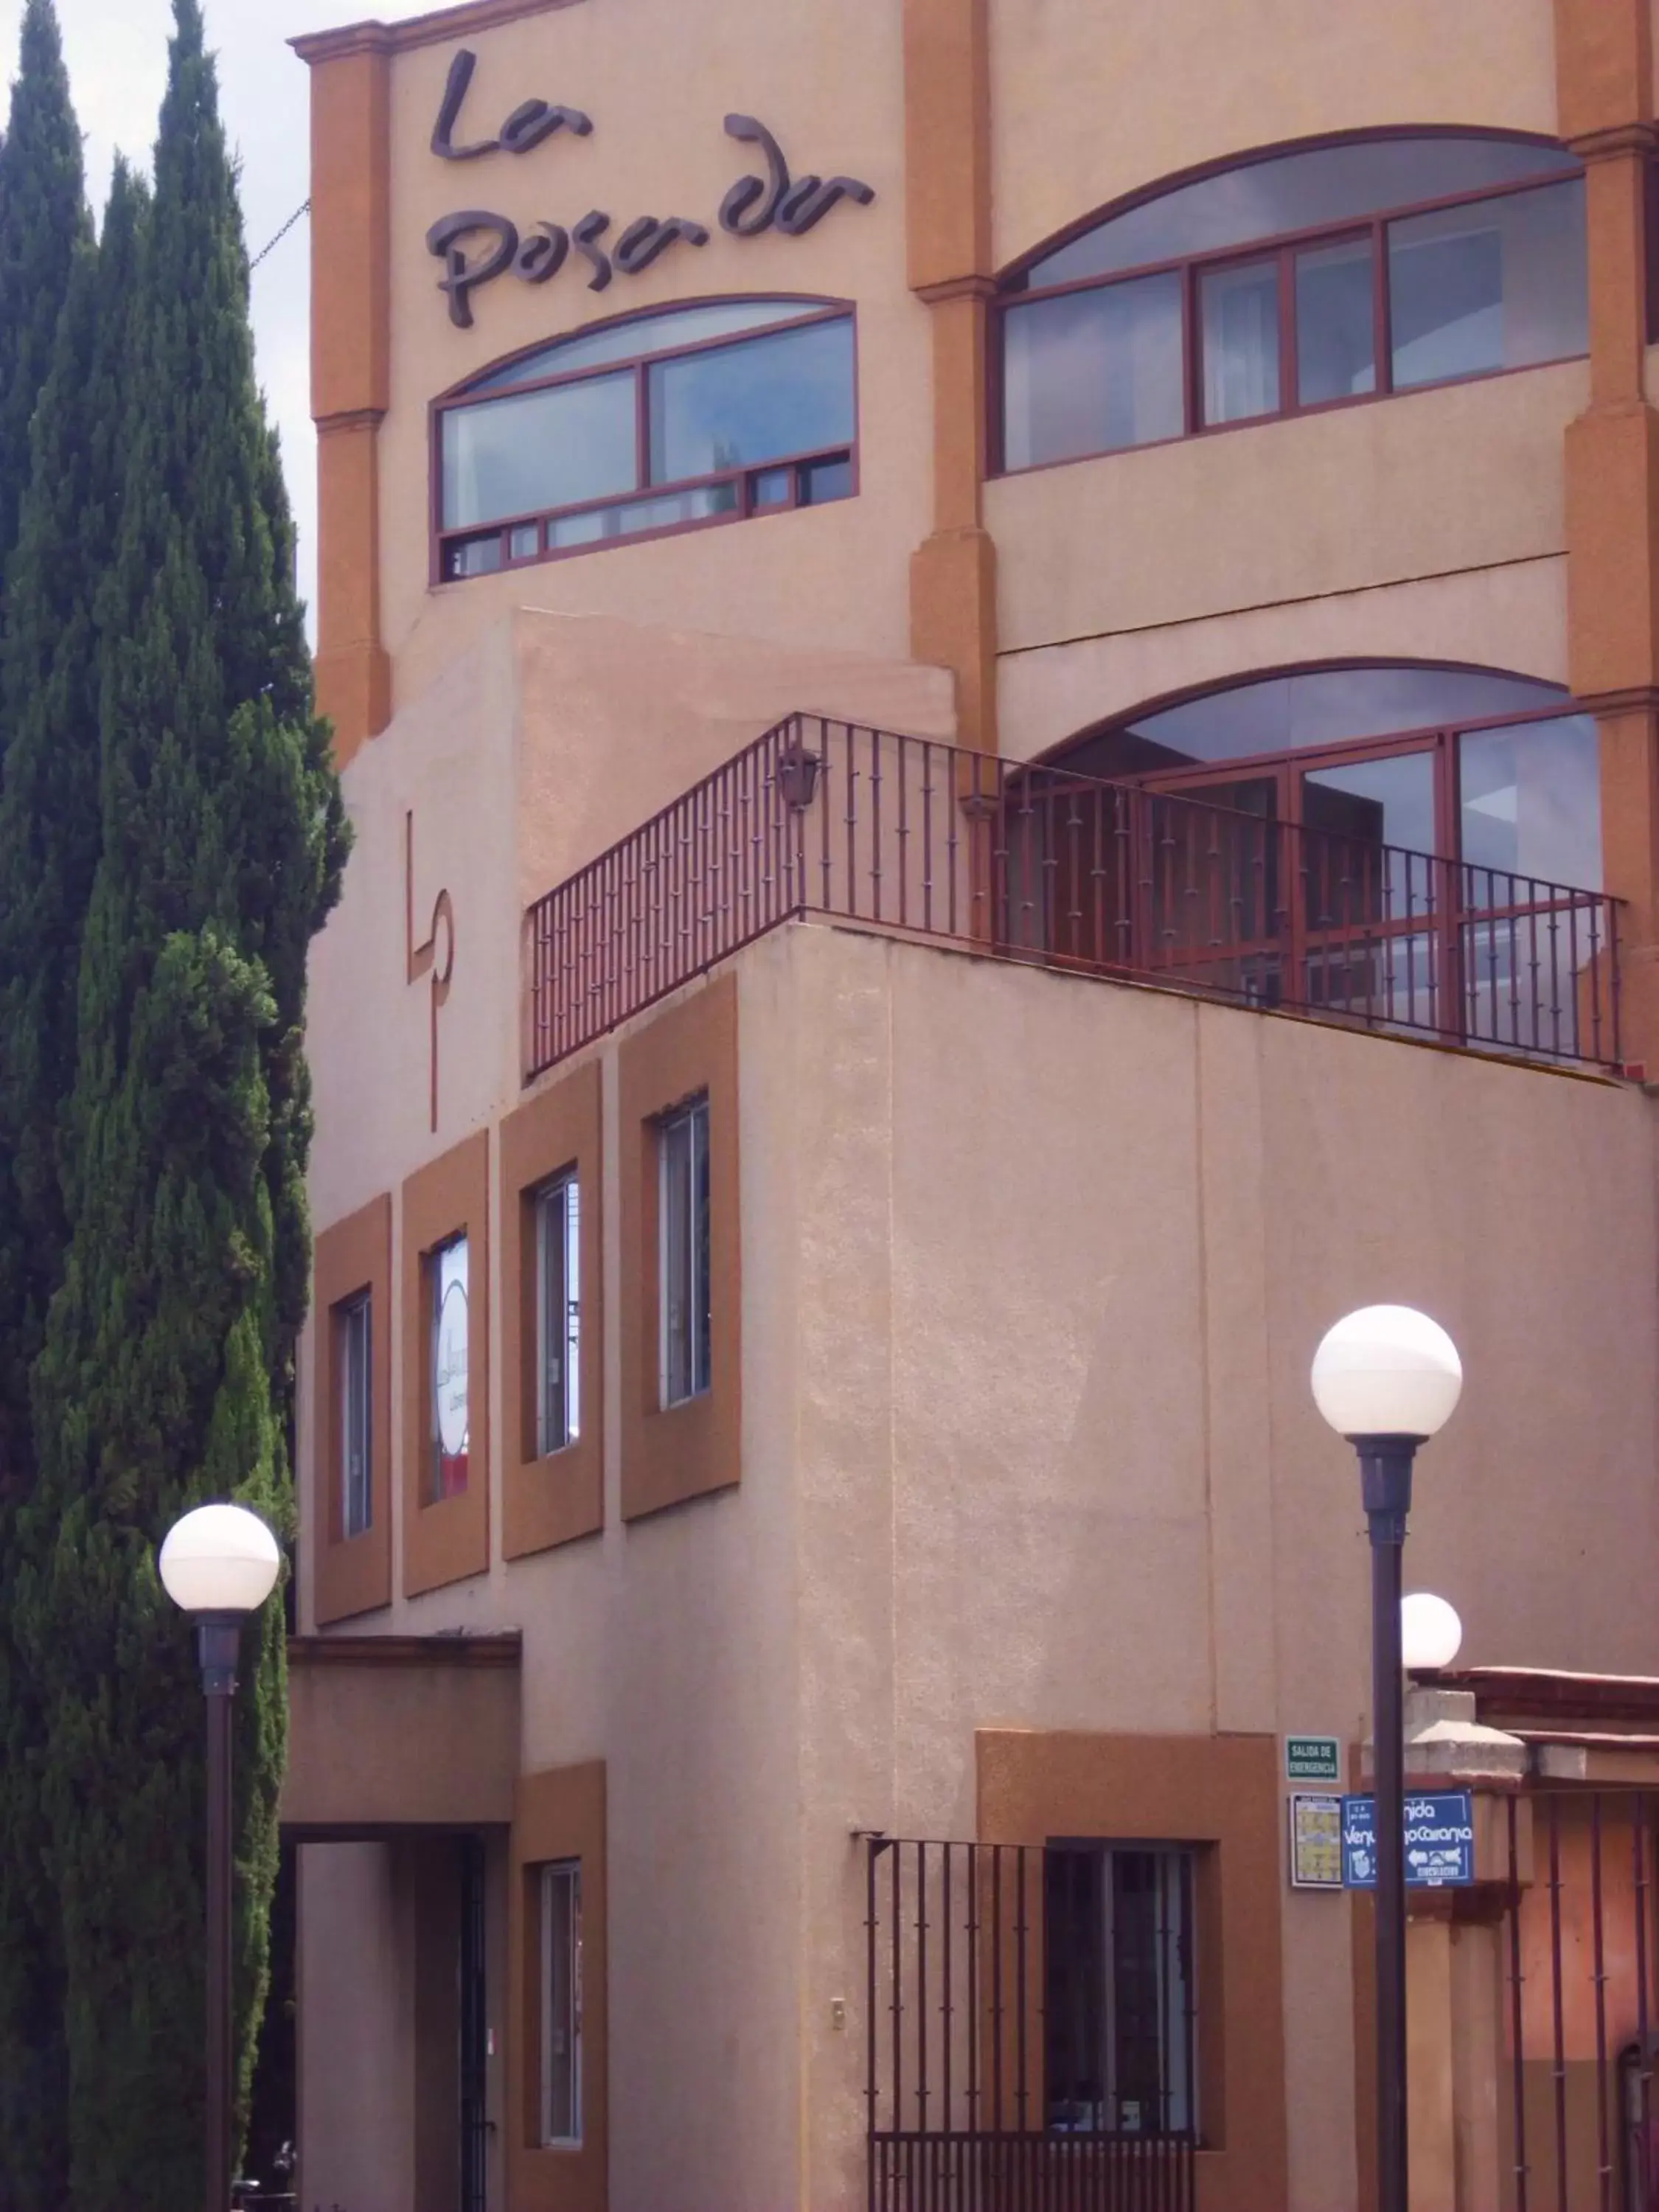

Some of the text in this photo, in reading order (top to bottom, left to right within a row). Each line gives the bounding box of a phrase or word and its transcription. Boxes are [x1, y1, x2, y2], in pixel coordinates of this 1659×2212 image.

[431, 49, 593, 161] La
[425, 112, 875, 329] Posada
[1290, 1761, 1335, 1773] EMERGENCIA
[1291, 1745, 1331, 1757] SALIDA DE
